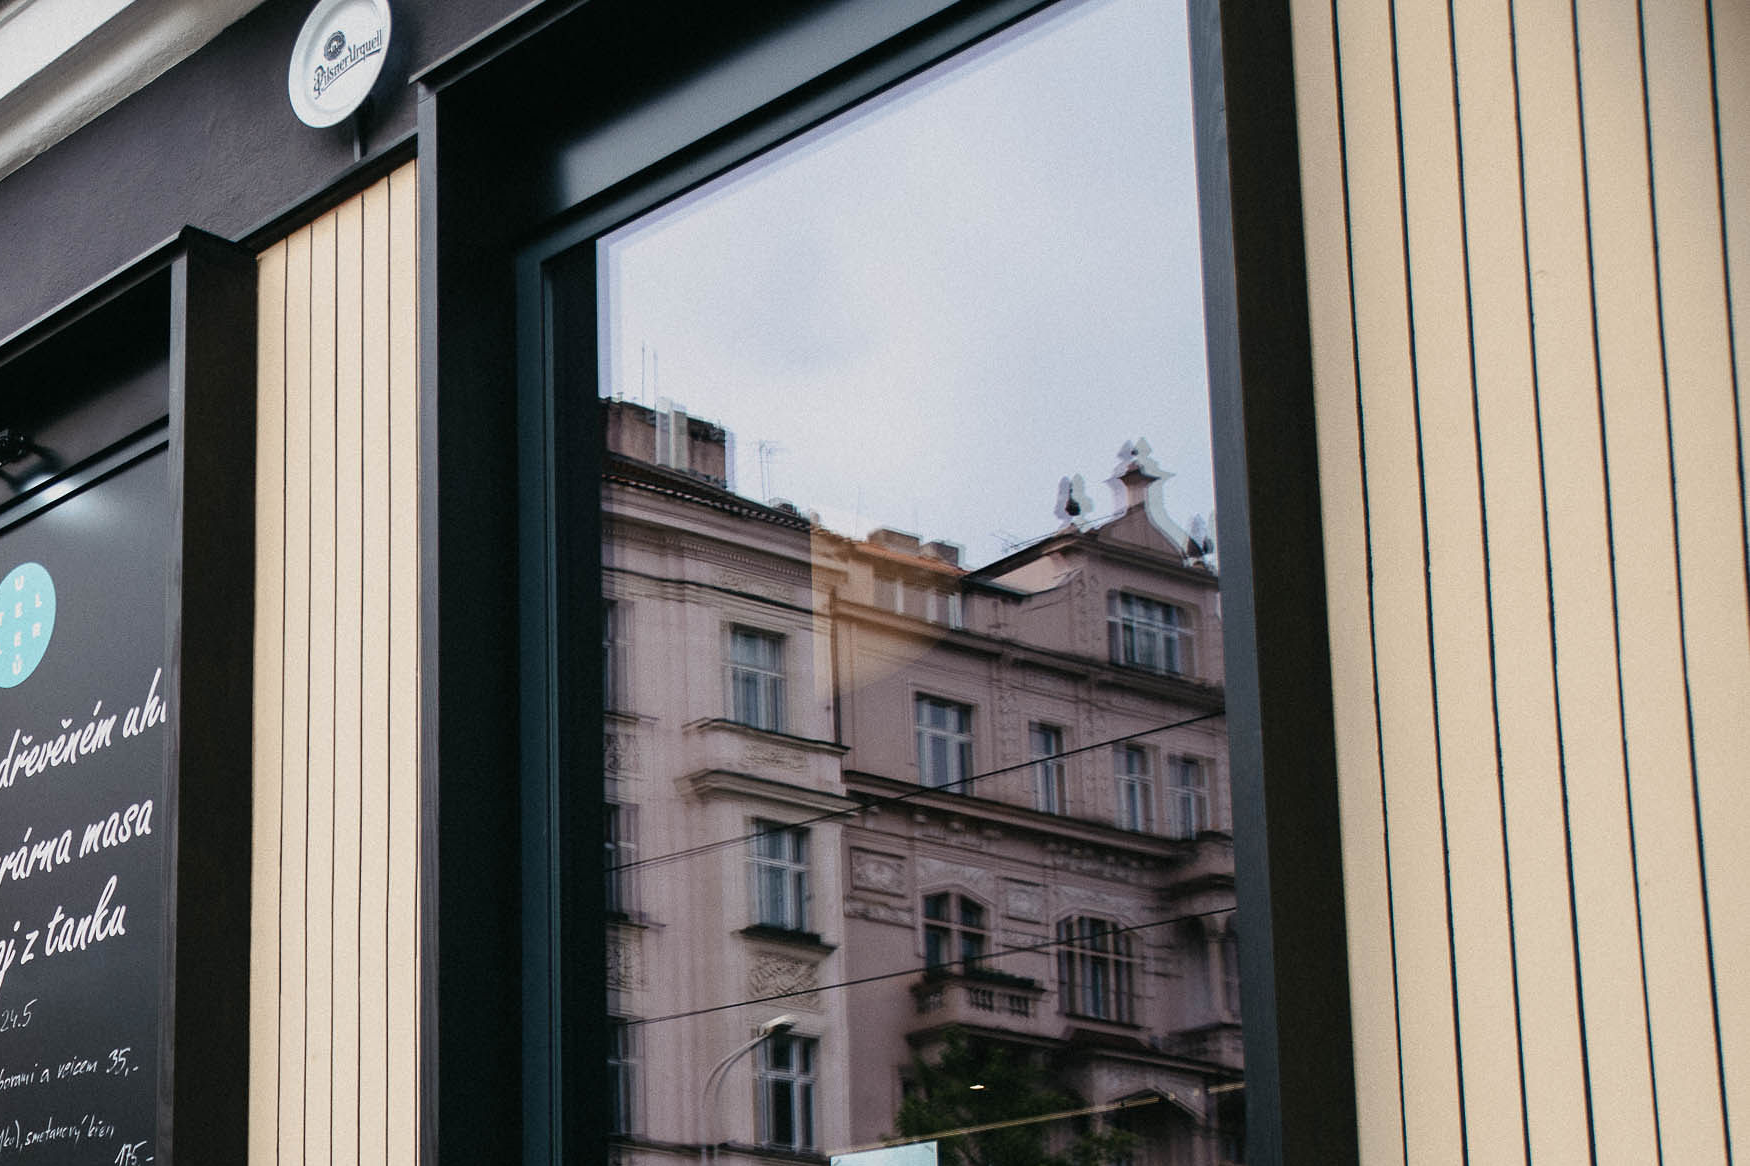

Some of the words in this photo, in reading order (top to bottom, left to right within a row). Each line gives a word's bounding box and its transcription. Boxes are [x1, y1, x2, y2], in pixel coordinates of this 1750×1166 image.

[313, 56, 350, 100] Pilsner
[347, 28, 382, 63] Urquell
[78, 799, 153, 858] masa
[20, 929, 40, 965] z
[45, 874, 127, 956] tanku
[39, 1068, 50, 1084] a
